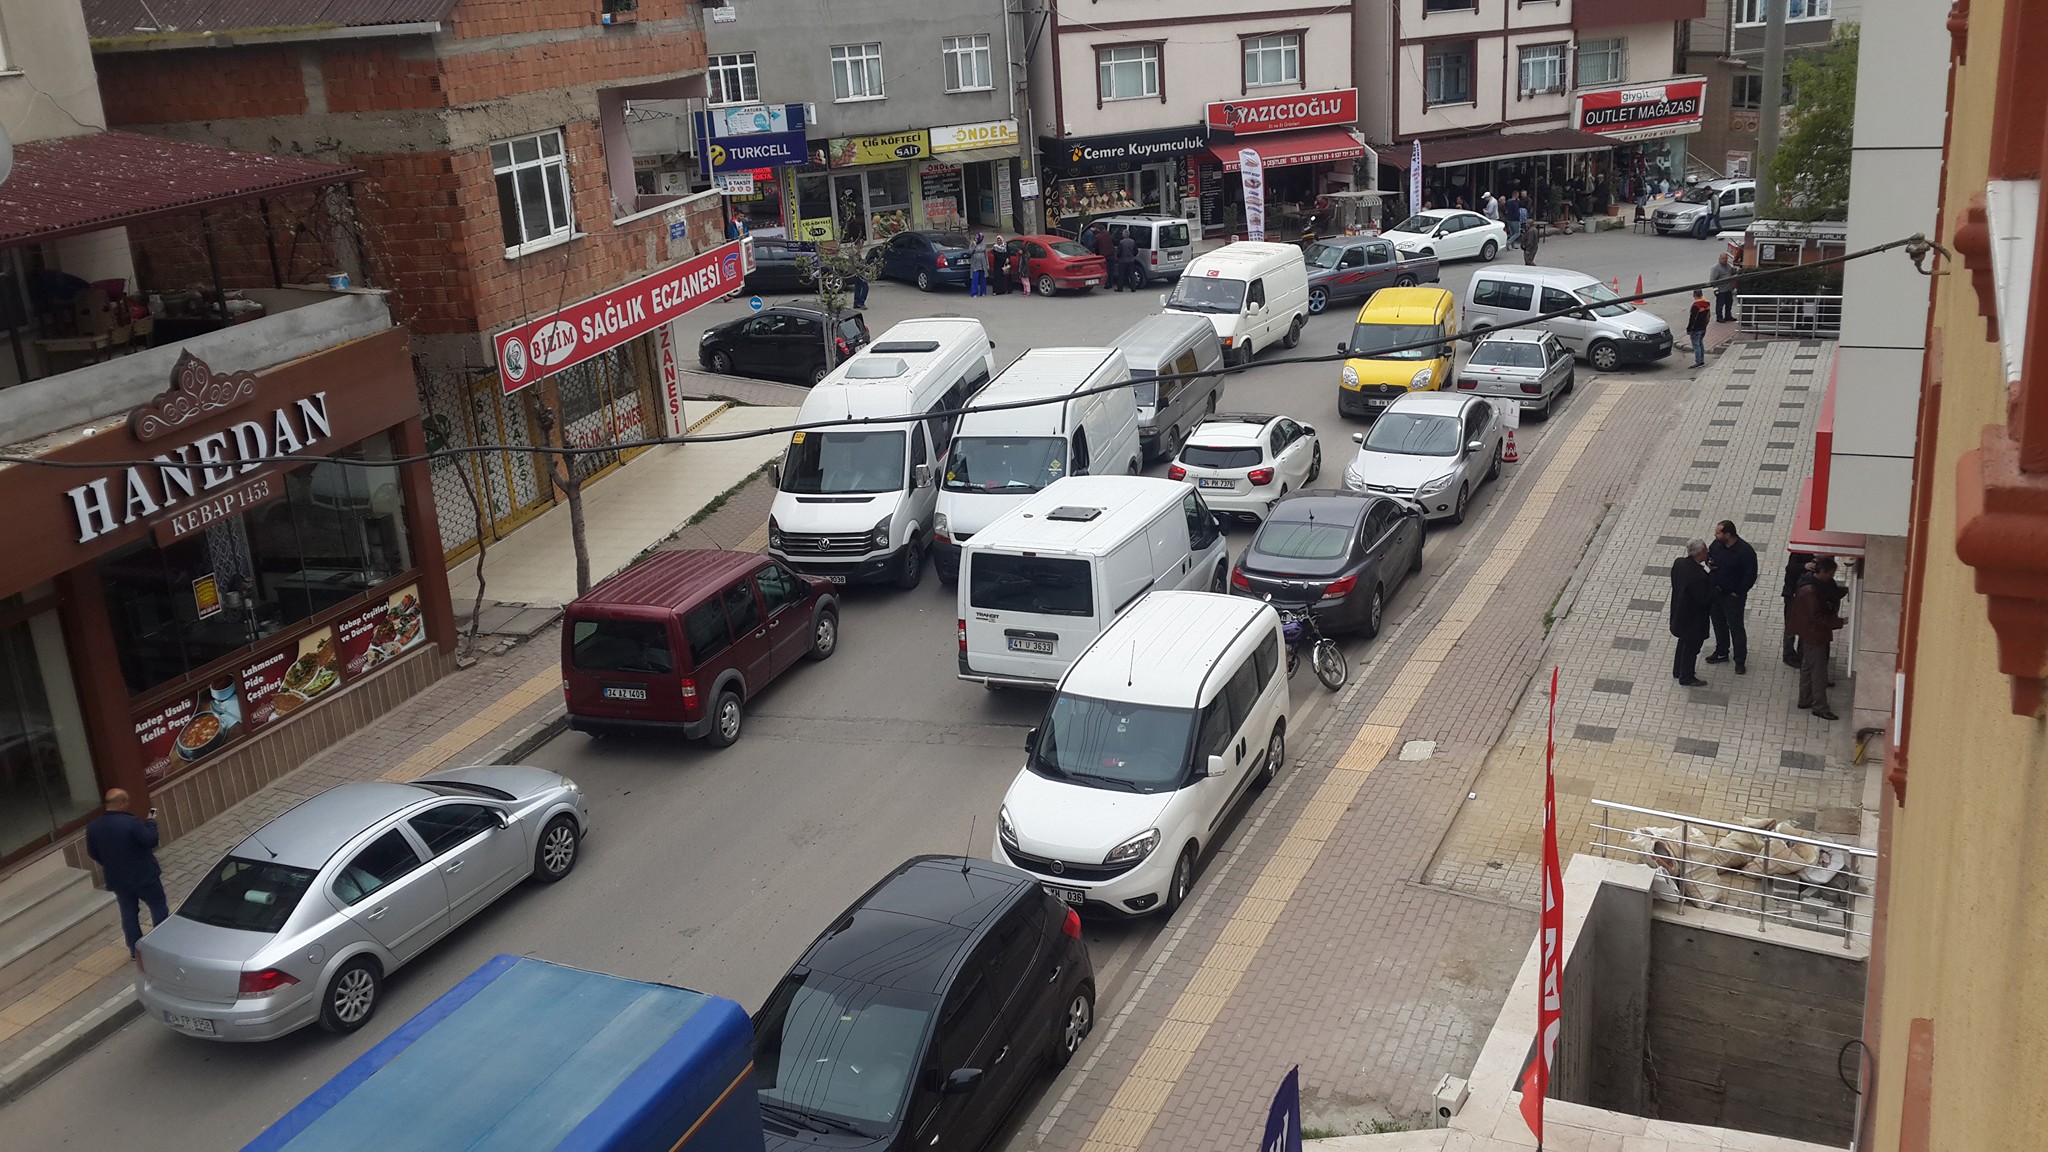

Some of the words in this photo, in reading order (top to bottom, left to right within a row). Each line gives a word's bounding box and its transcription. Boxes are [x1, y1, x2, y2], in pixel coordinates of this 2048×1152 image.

[1238, 97, 1342, 123] YAZICIOĞLU
[1586, 107, 1636, 125] OUTLET
[1638, 100, 1696, 119] MAĞAZASI
[862, 138, 879, 149] ÇİĞ
[881, 132, 921, 146] KÖFTECİ
[956, 125, 1009, 142] ÖNDER
[729, 143, 791, 160] TURKCELL
[896, 146, 920, 155] SAİT
[1084, 147, 1125, 160] Cemre
[1128, 136, 1204, 157] Kuyumculuk
[531, 326, 575, 359] BİZİM
[580, 299, 646, 344] SAĞLIK
[651, 256, 721, 314] ECZANESİ
[64, 391, 333, 544] HANEDAN
[173, 492, 235, 537] KEBAP
[239, 481, 270, 507] 1453
[338, 617, 362, 633] Kebap
[362, 601, 390, 622] Çeşitleri
[340, 635, 350, 643] ve
[350, 621, 374, 640] Dürüm
[1013, 639, 1022, 649] 41
[1025, 640, 1031, 649] U
[1033, 641, 1051, 652] 3633
[241, 651, 285, 678] Lahmacun
[244, 674, 265, 691] Pide
[246, 678, 281, 703] Çeşitleri
[607, 688, 616, 697] 34
[617, 689, 627, 698] AZ
[629, 689, 645, 699] 1409
[135, 711, 164, 735] Antep
[164, 699, 191, 718] Usulü
[140, 725, 167, 744] Kelle
[168, 714, 191, 734] Paça
[1067, 891, 1082, 902] 036
